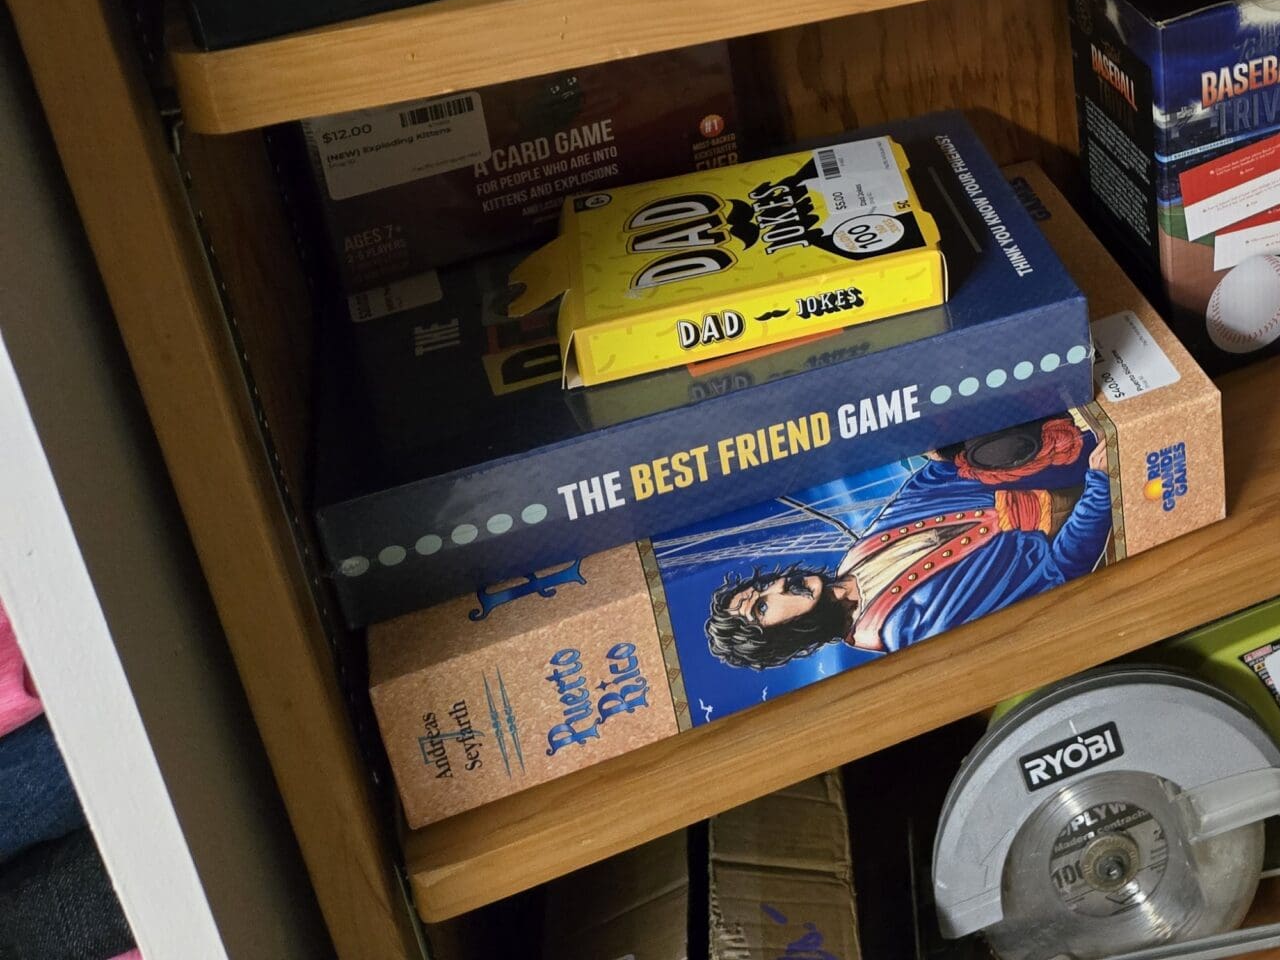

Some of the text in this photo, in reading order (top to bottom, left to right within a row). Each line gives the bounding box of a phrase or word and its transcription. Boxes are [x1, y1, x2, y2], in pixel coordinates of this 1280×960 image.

[1090, 43, 1137, 111] BASEBALL
[322, 123, 373, 144] $12.00
[362, 134, 414, 154] Exploding
[473, 160, 489, 178] A
[491, 137, 551, 172] CARD
[554, 119, 615, 154] GAME
[704, 118, 719, 132] #1
[476, 145, 618, 196] FOR PEOPLE WHO ARE INTO
[481, 163, 620, 213] KITTENS AND EXPLOSIONS
[958, 174, 982, 202] YOUR
[626, 193, 730, 288] DAD
[750, 182, 808, 256] JOKES
[848, 224, 882, 249] 100
[973, 197, 1002, 229] KNOW
[991, 226, 1013, 246] YOU
[1004, 244, 1033, 277] THINK
[678, 287, 864, 350] DAD JOKES
[1102, 373, 1125, 398] $40.00
[558, 383, 921, 521] THE BEST FRIEND GAME
[1146, 452, 1161, 480] RIO
[1160, 446, 1175, 512] GRANDE
[1173, 442, 1188, 497] GAMES
[546, 648, 601, 756] Puerto
[596, 642, 650, 724] Rico
[421, 712, 453, 779] Andreas
[449, 699, 482, 771] Seyfarth
[1024, 730, 1116, 785] RYOBI
